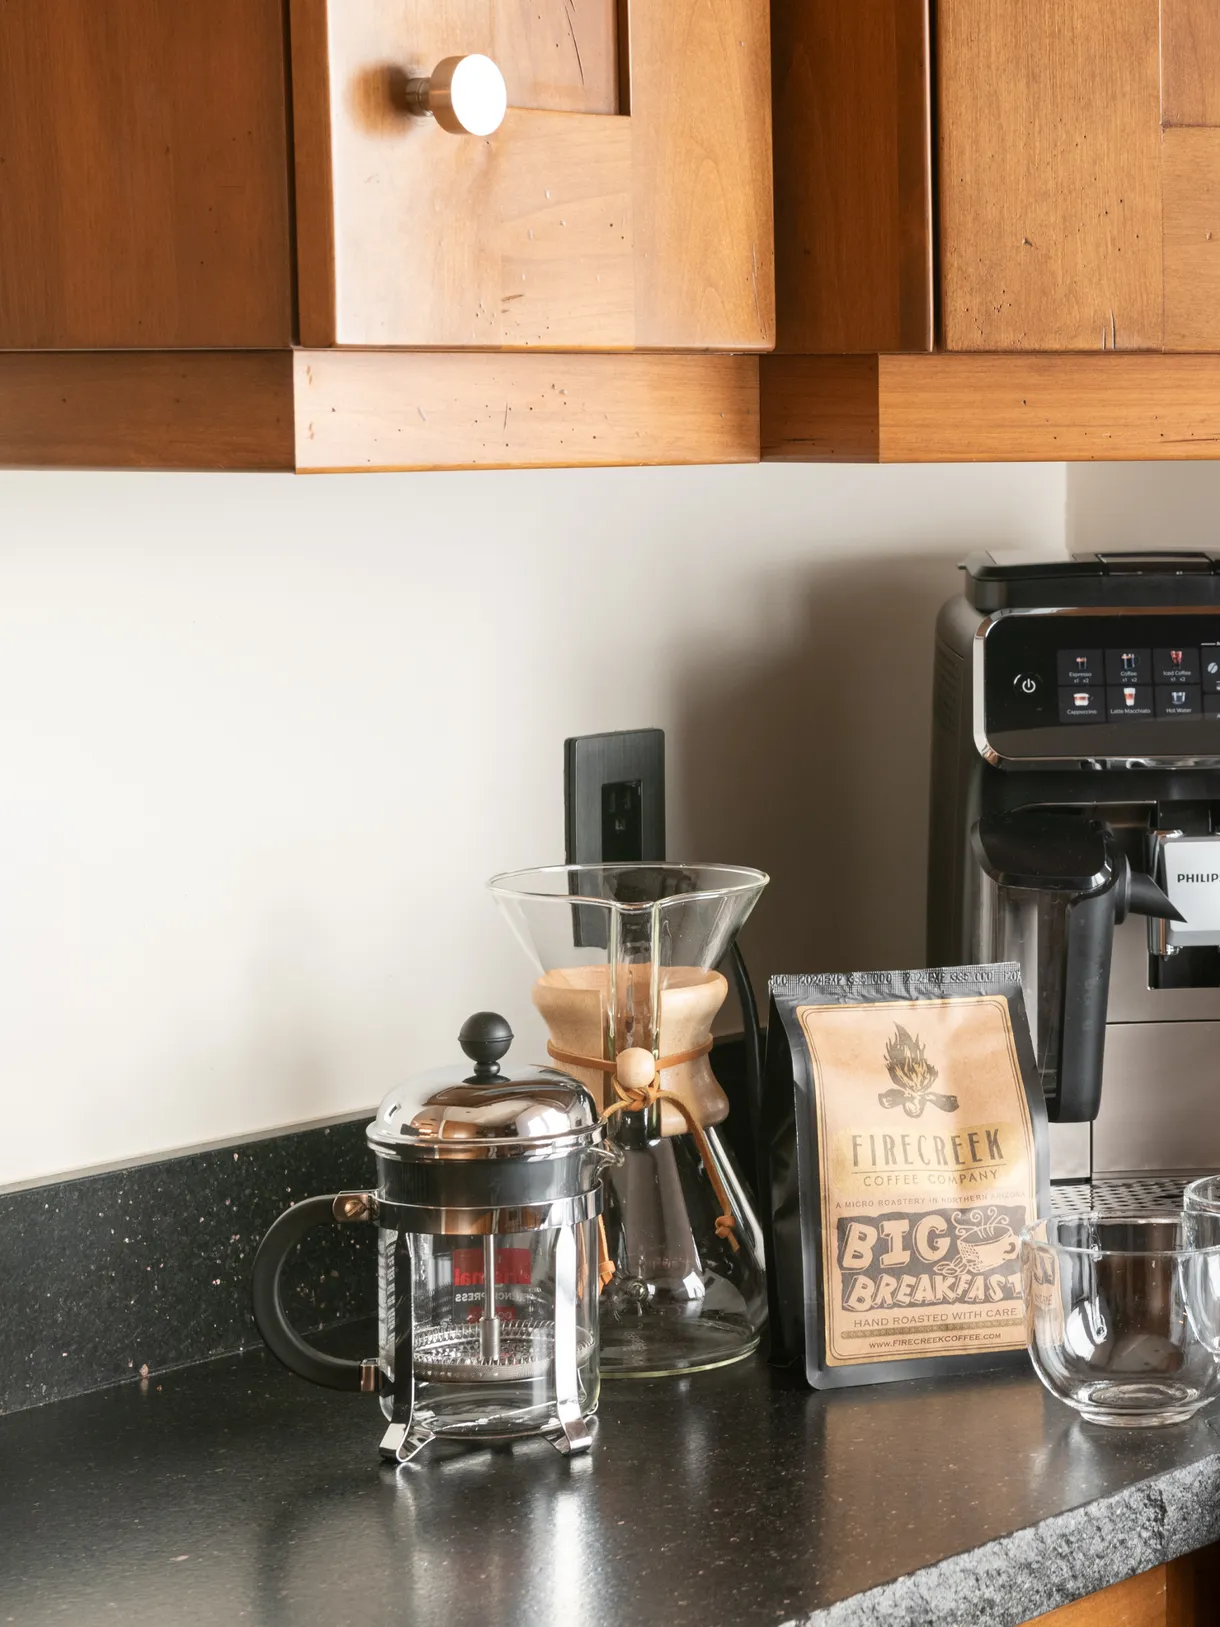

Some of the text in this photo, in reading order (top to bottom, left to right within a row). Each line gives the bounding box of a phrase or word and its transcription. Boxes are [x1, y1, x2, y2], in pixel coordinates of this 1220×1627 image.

[851, 1128, 1004, 1167] FIRECREEK
[863, 1169, 999, 1187] COFFEE COMPANY
[835, 1191, 1026, 1210] A MICRO ROASTERY IN NORTHERN ARIZONA
[840, 1214, 951, 1273] BIG
[843, 1271, 1022, 1312] BREAKFAST
[853, 1307, 1019, 1328] HAND ROASTED WITH CARE
